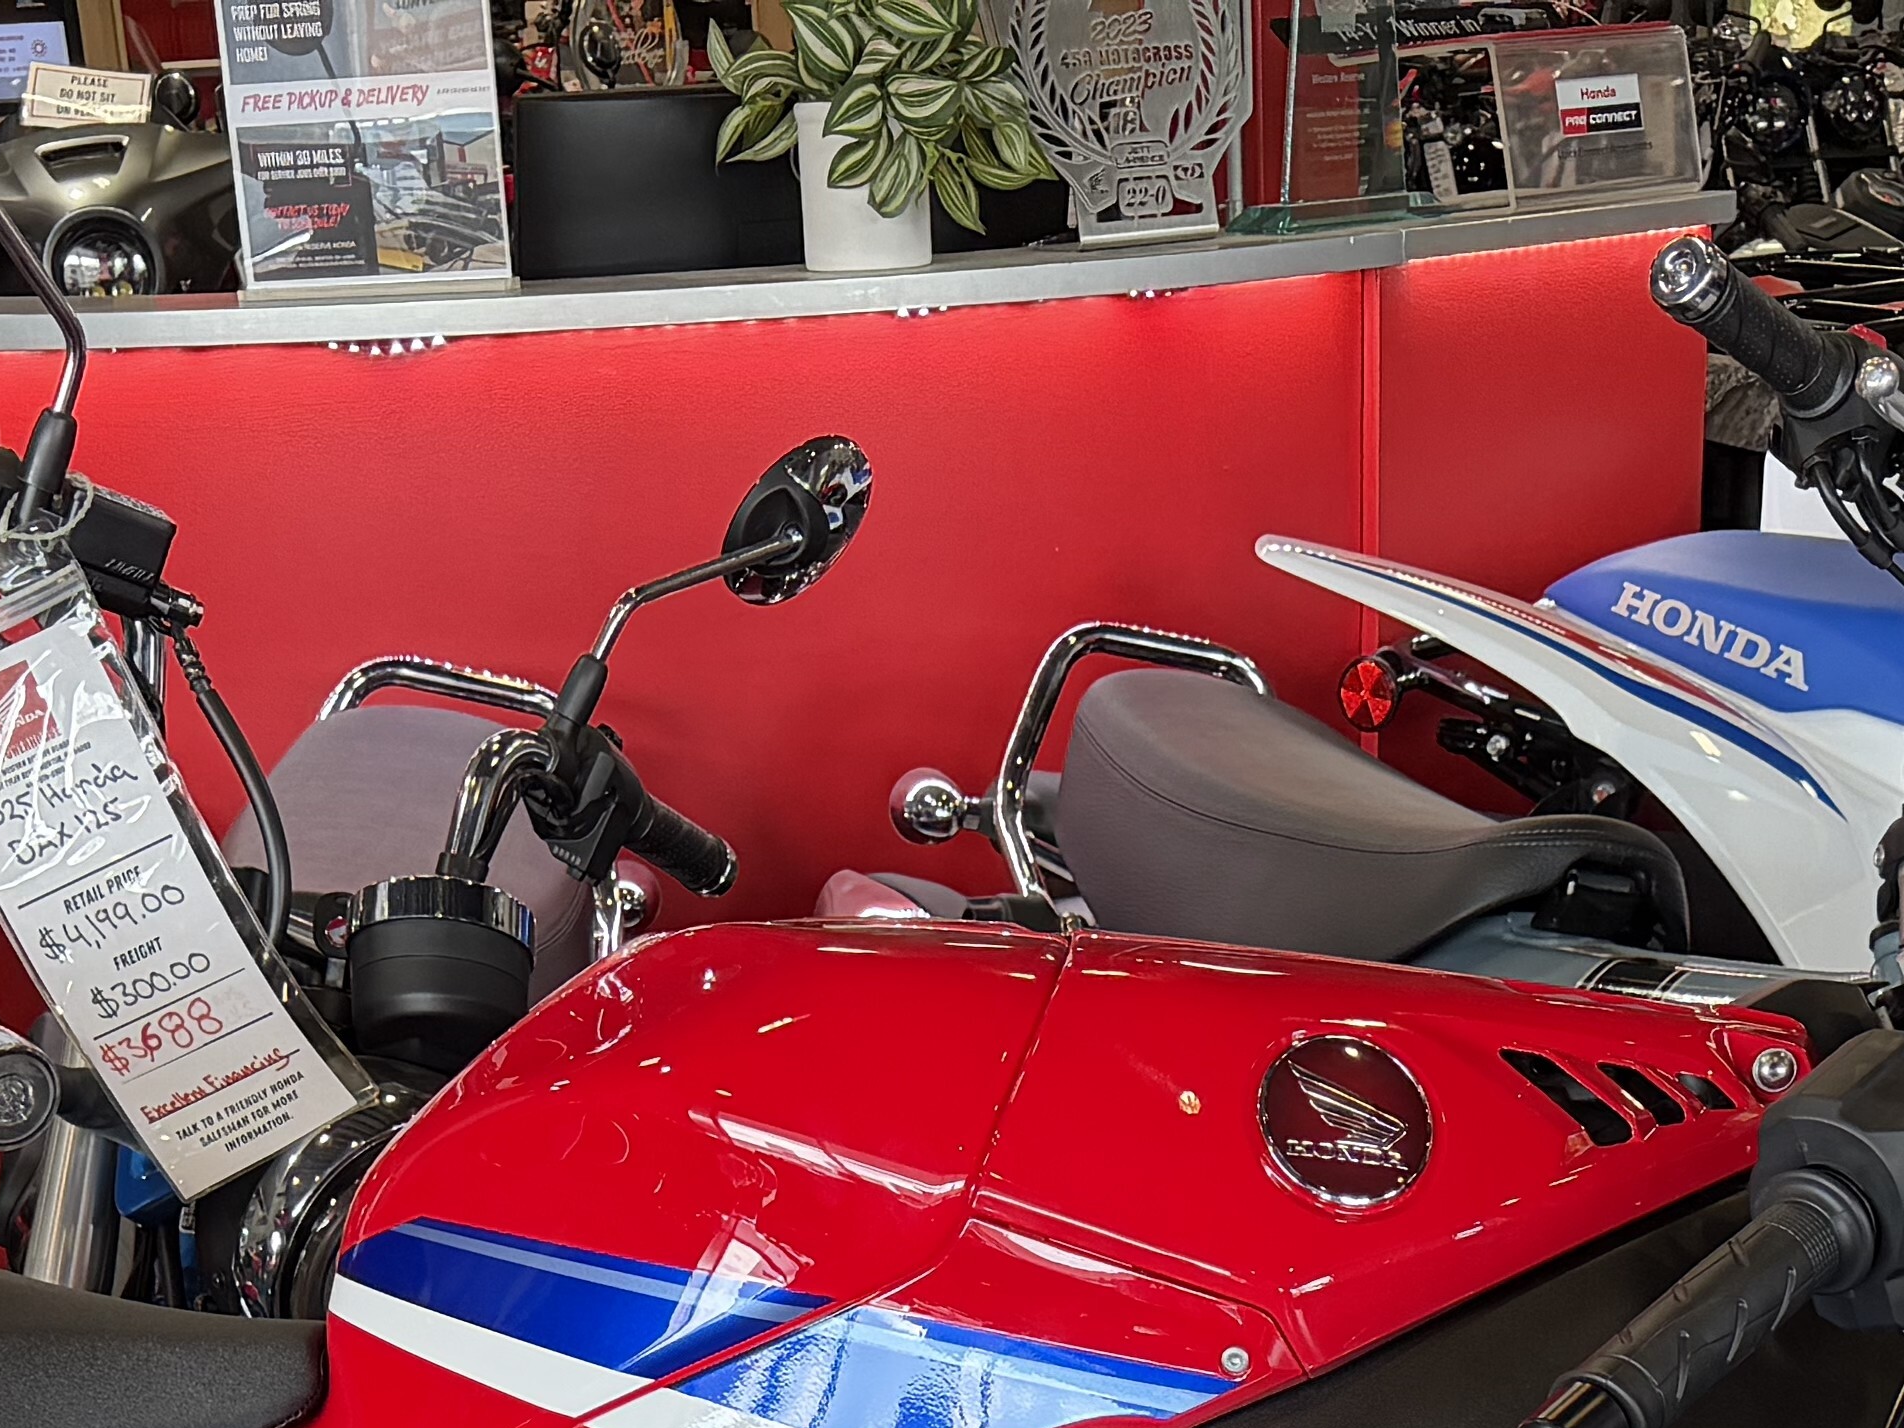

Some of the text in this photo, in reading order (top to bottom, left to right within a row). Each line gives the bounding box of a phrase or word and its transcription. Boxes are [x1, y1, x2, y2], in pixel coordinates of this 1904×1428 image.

[231, 3, 258, 21] PREP
[283, 1, 321, 18] SPRING
[1091, 10, 1154, 41] 2023
[1395, 18, 1459, 38] Winner
[1460, 16, 1483, 34] in
[234, 22, 324, 41] WITHOUT LEAVING
[1099, 43, 1194, 67] MOTOCROSS
[70, 74, 110, 89] PLEASE
[76, 89, 97, 101] NOT
[99, 91, 116, 104] SIT
[241, 93, 283, 113] FREE
[286, 88, 338, 111] PICKUP
[341, 90, 353, 108] &
[356, 83, 430, 107] DELIVERY
[1070, 62, 1193, 106] Champion
[1580, 85, 1617, 101] Honda
[1565, 110, 1637, 127] PRO CONNECT
[258, 151, 295, 168] WITHIN
[1125, 184, 1166, 209] 22-0
[1611, 581, 1809, 692] HONDA
[39, 762, 139, 808] Honda
[8, 797, 123, 864] DAX 125
[64, 865, 142, 915] RETAIL PRICE
[38, 884, 185, 963] $4,199.00
[113, 936, 163, 971] FREIGHT
[90, 952, 211, 1019] $300.00
[140, 1047, 290, 1125] Excellent Financing
[176, 1070, 305, 1142] TALK TO A FRIENDLY HONDA
[199, 1090, 300, 1149] SALESMAN FOR MORE
[224, 1114, 295, 1153] INFORMATION.
[1286, 1138, 1409, 1171] HONDA
